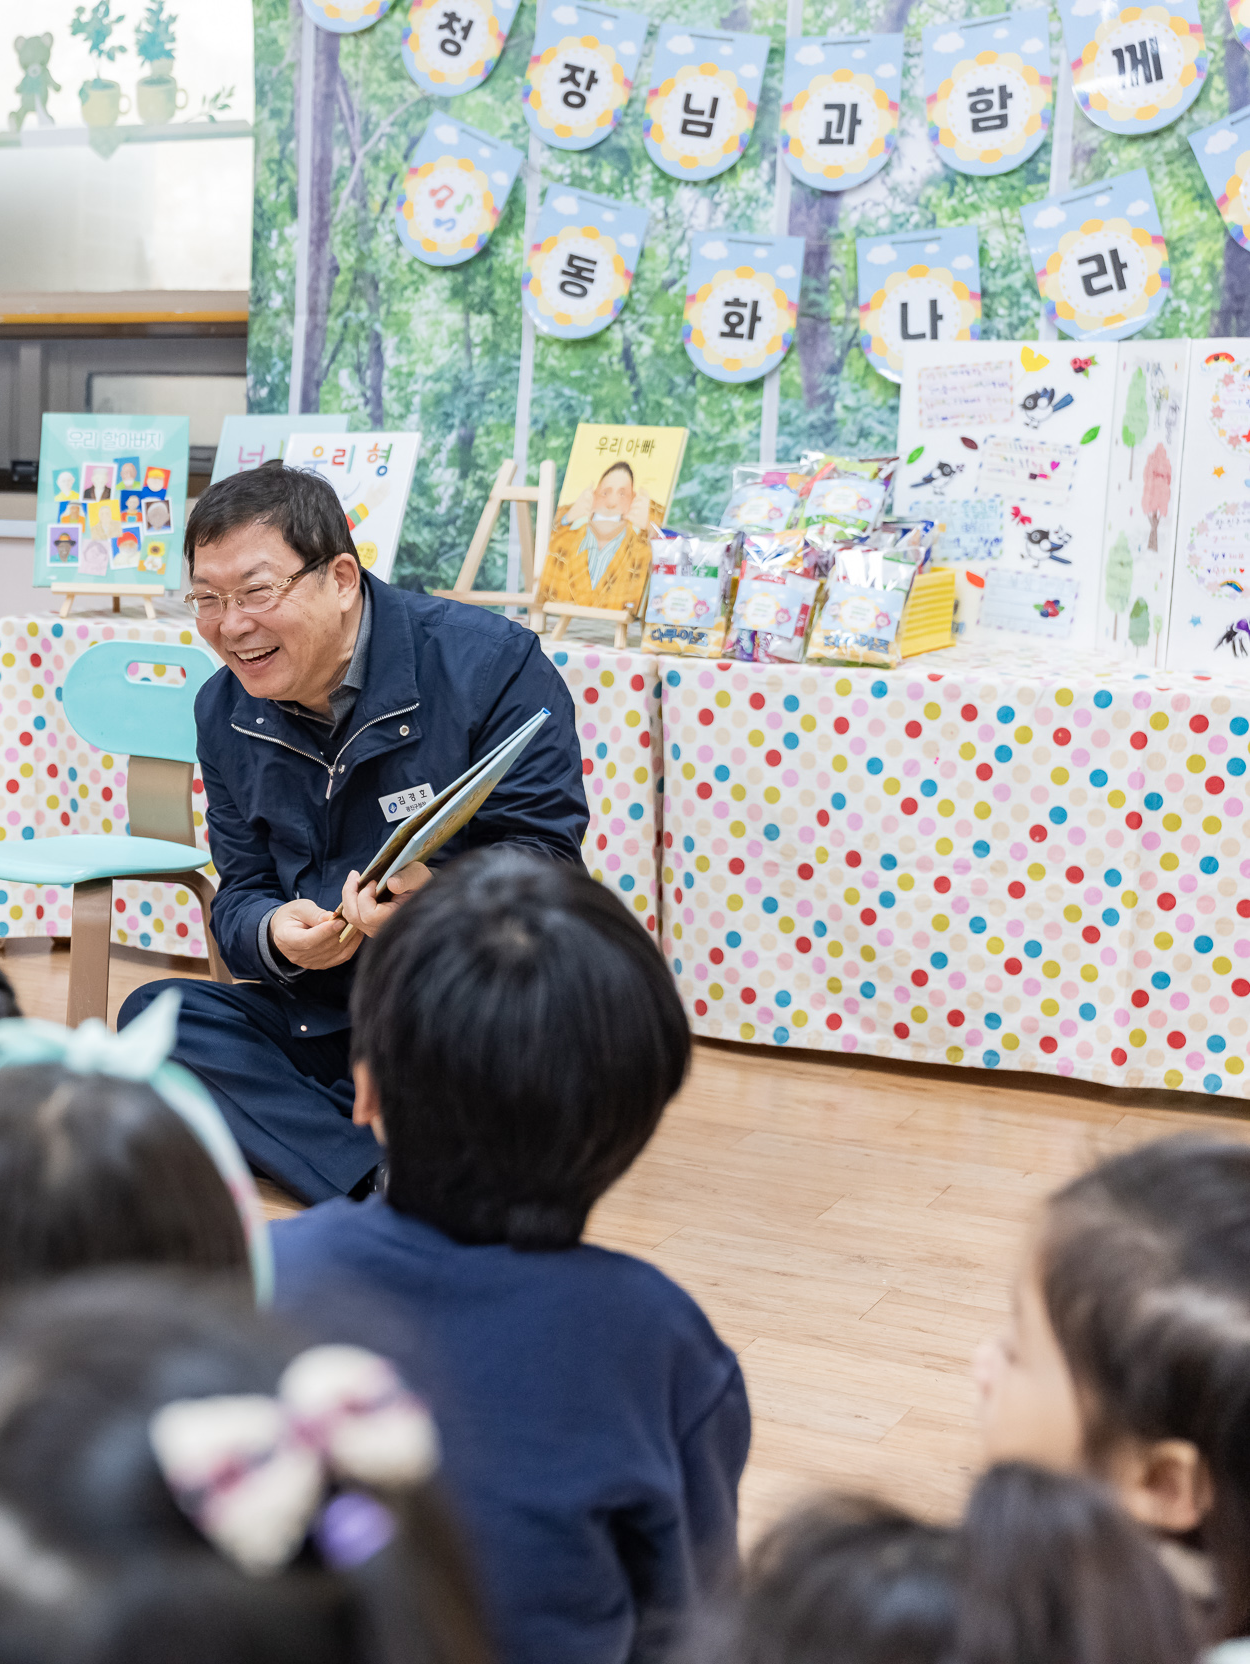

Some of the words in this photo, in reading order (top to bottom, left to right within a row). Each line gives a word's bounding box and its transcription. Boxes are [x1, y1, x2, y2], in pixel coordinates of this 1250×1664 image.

[438, 11, 474, 57] 청
[559, 63, 599, 109] 장
[680, 93, 719, 138] 님
[818, 103, 862, 145] 과
[968, 84, 1013, 133] 함
[1112, 38, 1164, 87] 께
[559, 253, 598, 298] 동
[720, 297, 762, 340] 화
[901, 299, 943, 341] 나
[1078, 248, 1128, 297] 라
[68, 430, 99, 449] 우리
[103, 430, 163, 450] 할아버지
[596, 437, 622, 456] 우리
[626, 438, 655, 458] 아빠
[303, 444, 356, 475] 우리
[367, 442, 393, 477] 형
